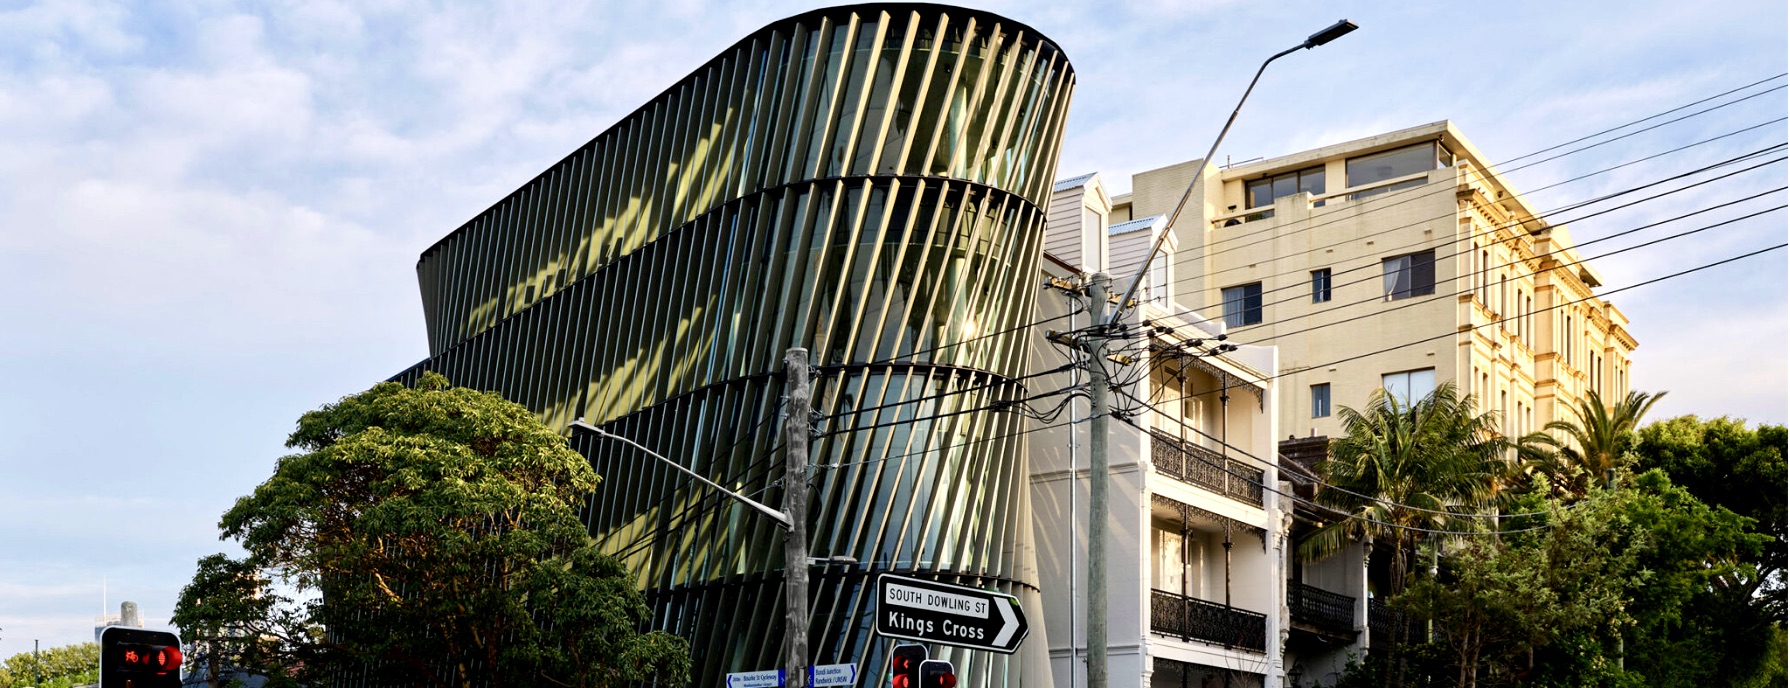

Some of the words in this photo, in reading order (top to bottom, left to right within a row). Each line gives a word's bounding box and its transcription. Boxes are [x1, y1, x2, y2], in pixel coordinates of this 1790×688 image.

[889, 588, 922, 604] SOUTH
[928, 594, 970, 612] DOWLING
[975, 602, 986, 614] ST
[889, 611, 934, 636] Kings
[943, 619, 984, 640] Cross
